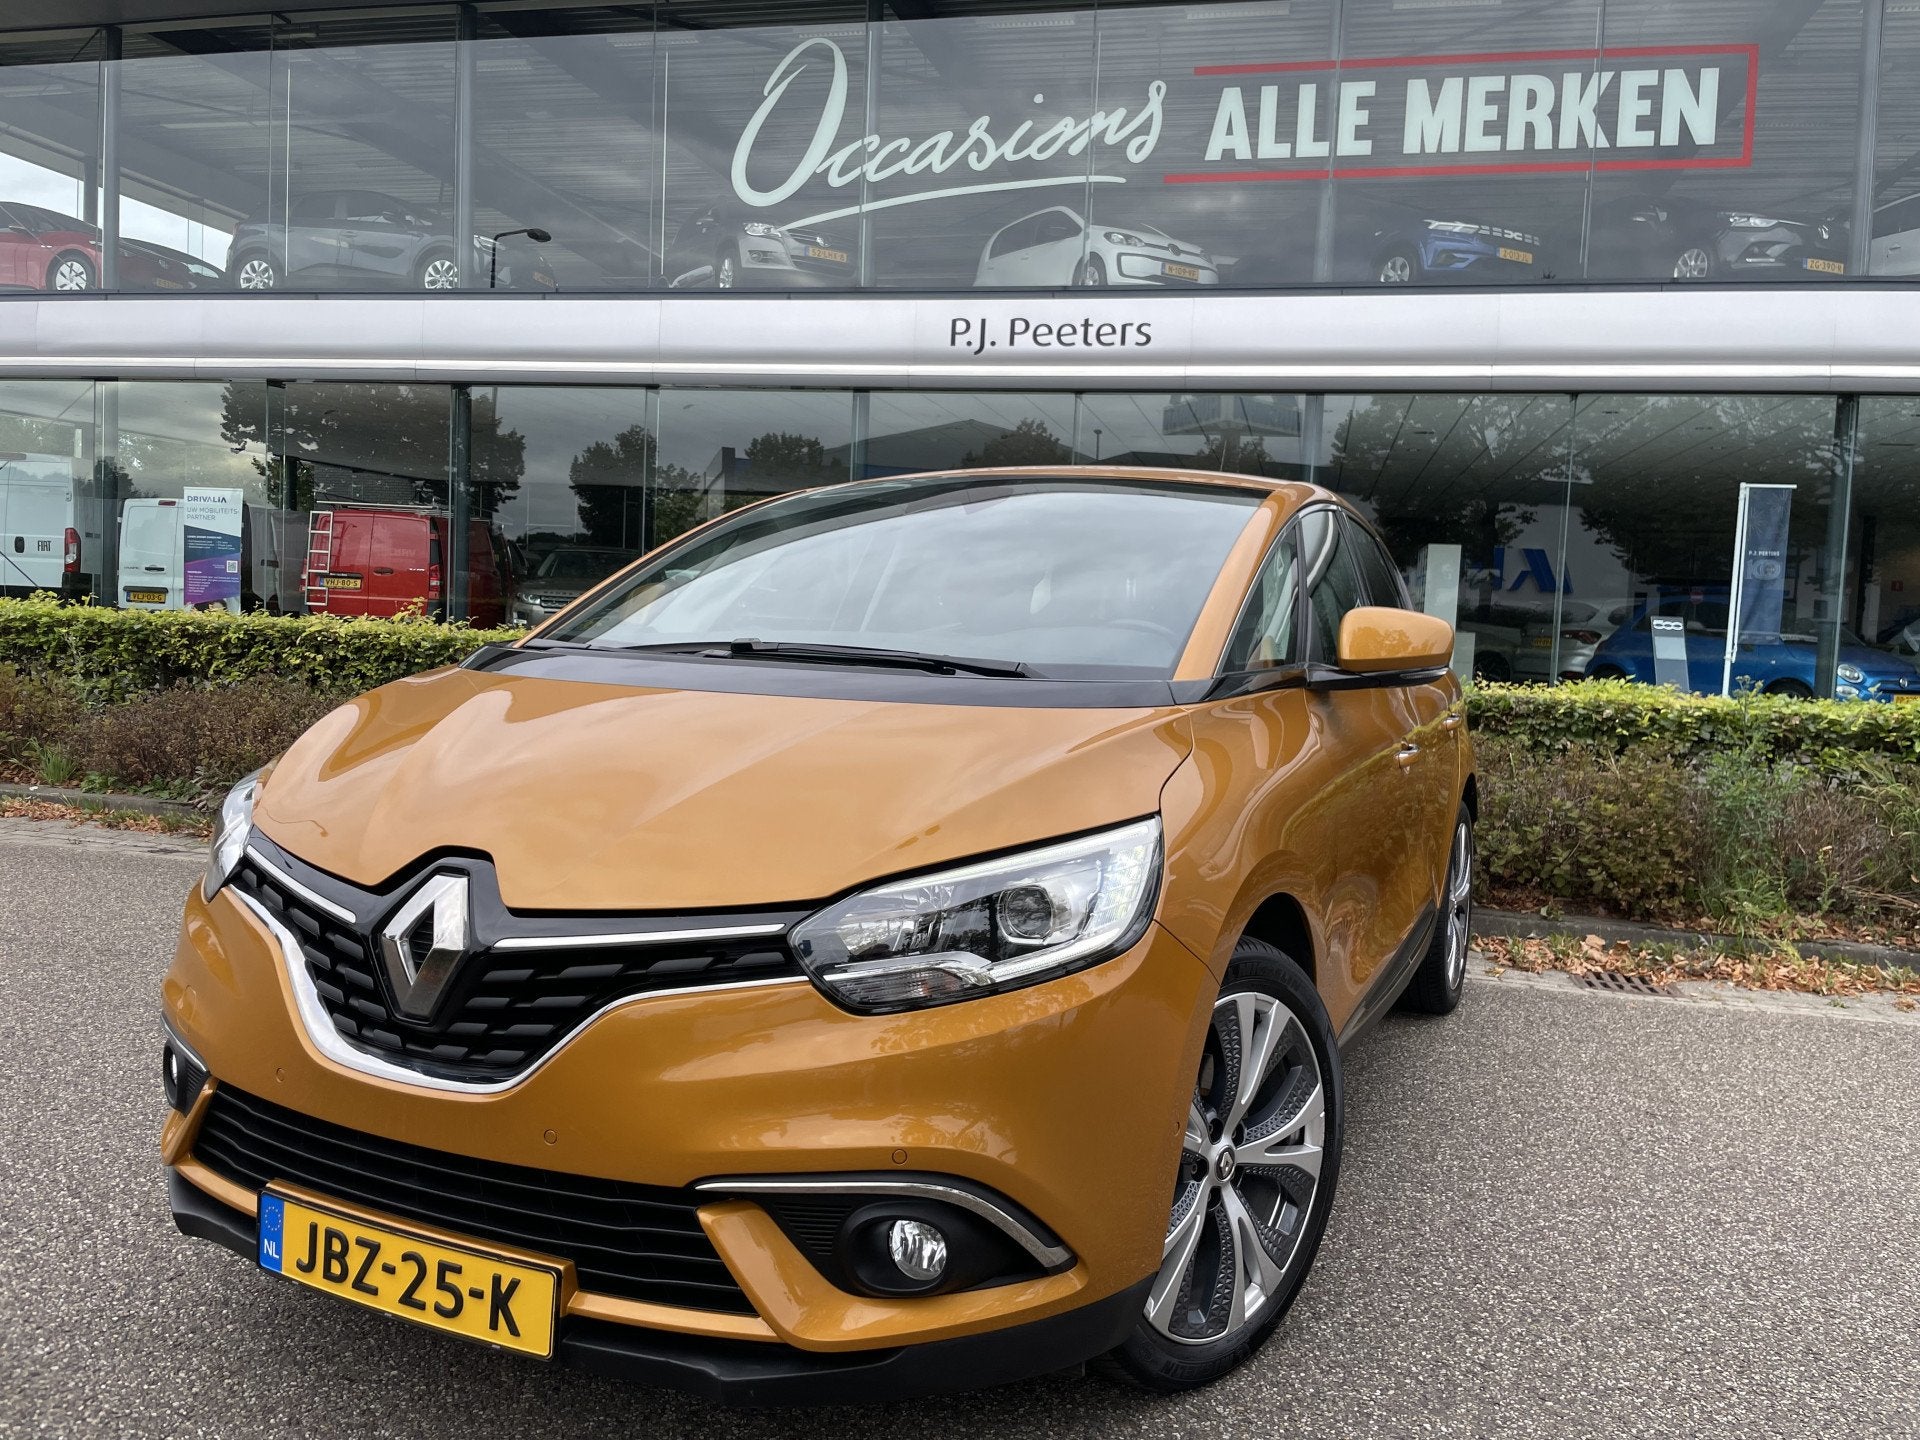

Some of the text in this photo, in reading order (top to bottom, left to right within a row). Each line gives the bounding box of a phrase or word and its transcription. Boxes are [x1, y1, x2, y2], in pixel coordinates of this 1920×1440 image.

[1204, 67, 1720, 161] ALLE MERKEN
[731, 37, 1167, 207] Occasions
[950, 317, 1152, 356] P.J. Peeters
[186, 495, 227, 503] DRIVALIA
[186, 506, 198, 514] UW
[186, 513, 216, 521] PARTNER
[37, 540, 51, 552] FIAT
[325, 578, 358, 587] VHJ-80-S
[1653, 619, 1683, 631] 500
[263, 1237, 280, 1259] NL
[296, 1221, 521, 1338] JBZ-25-K
